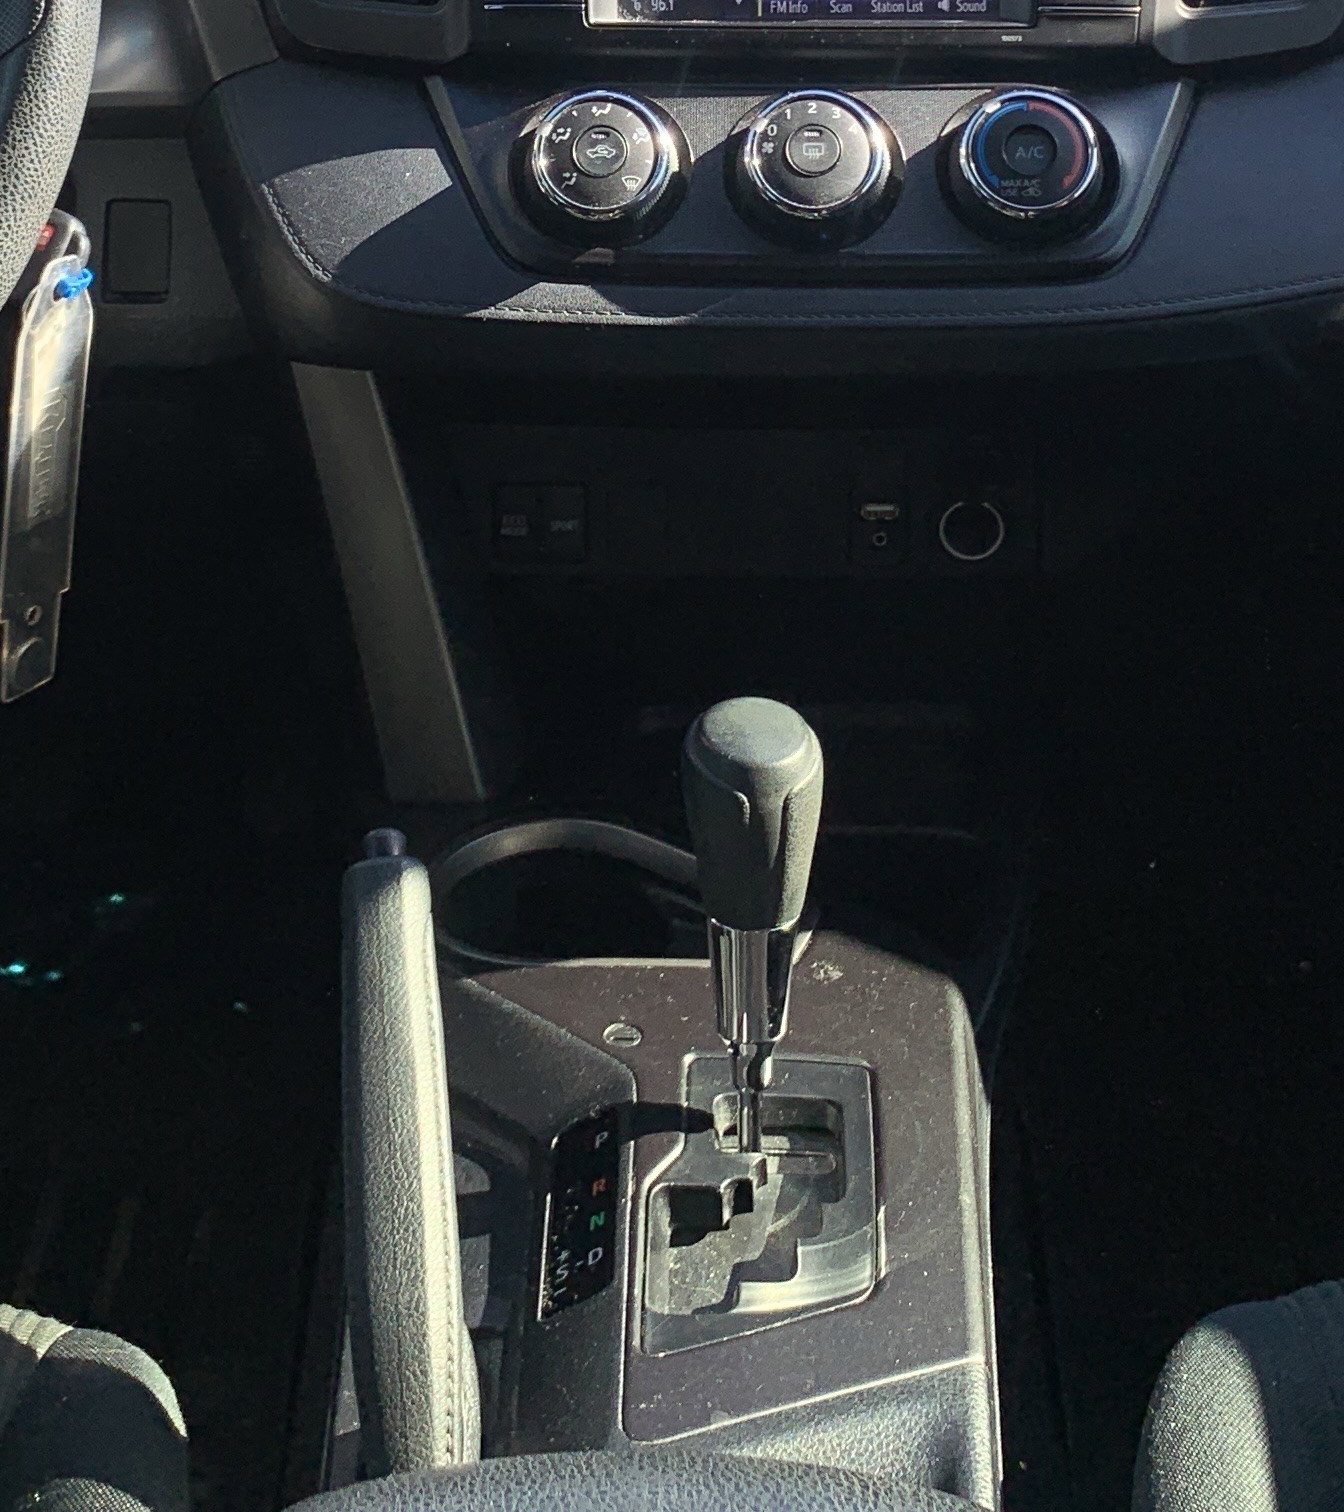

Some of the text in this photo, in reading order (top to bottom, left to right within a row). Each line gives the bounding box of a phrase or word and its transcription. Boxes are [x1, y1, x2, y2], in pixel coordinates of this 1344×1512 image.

[770, 0, 808, 14] FM Info
[829, 1, 853, 14] Scan
[871, 0, 923, 14] Station List
[956, 0, 987, 13] Sound
[784, 108, 792, 120] 1
[807, 102, 817, 115] 2
[831, 106, 842, 119] 3
[1015, 145, 1045, 159] A/C
[594, 1130, 609, 1148] P
[592, 1176, 607, 1197] R
[589, 1212, 605, 1232] N
[587, 1245, 604, 1267] D
